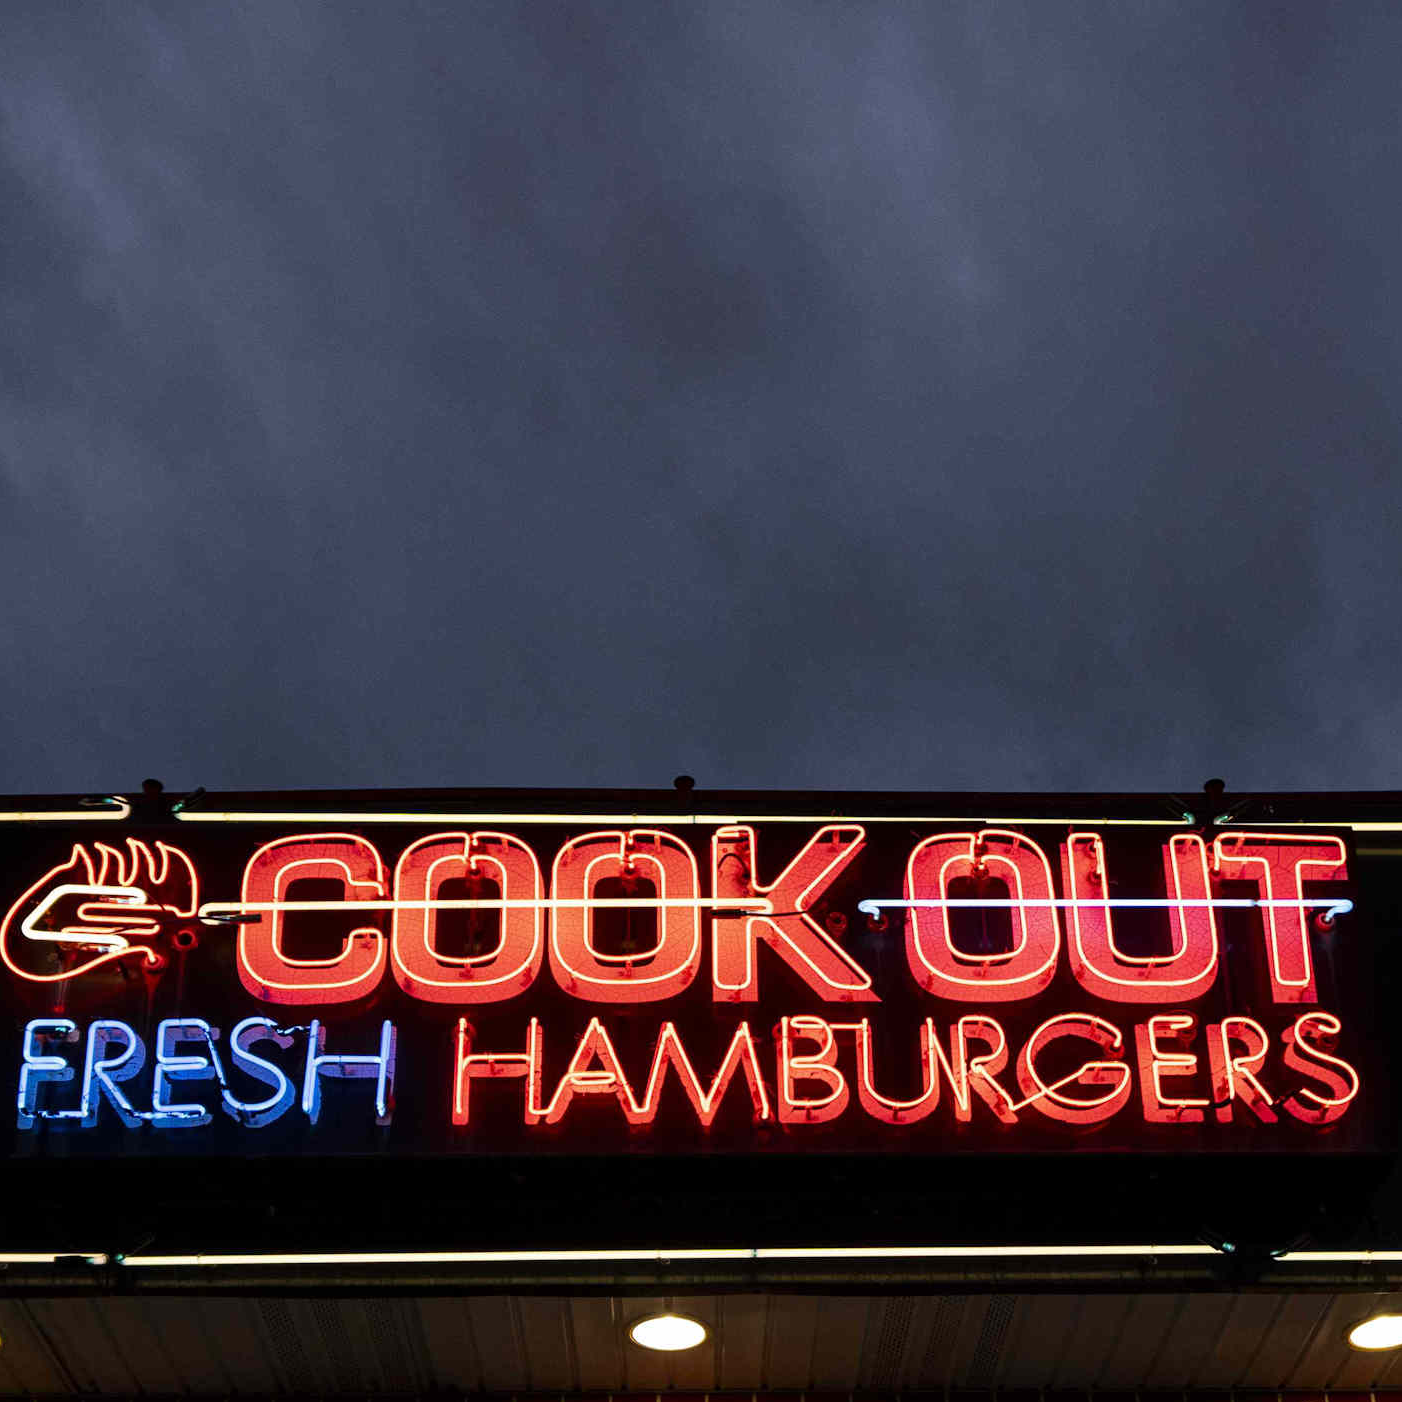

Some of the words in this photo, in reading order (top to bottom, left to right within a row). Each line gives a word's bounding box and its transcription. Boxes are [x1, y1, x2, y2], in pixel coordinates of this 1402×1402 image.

[238, 820, 870, 1004] COOK
[13, 1016, 395, 1128] FRESH
[451, 1012, 1361, 1126] HAMBURGERS
